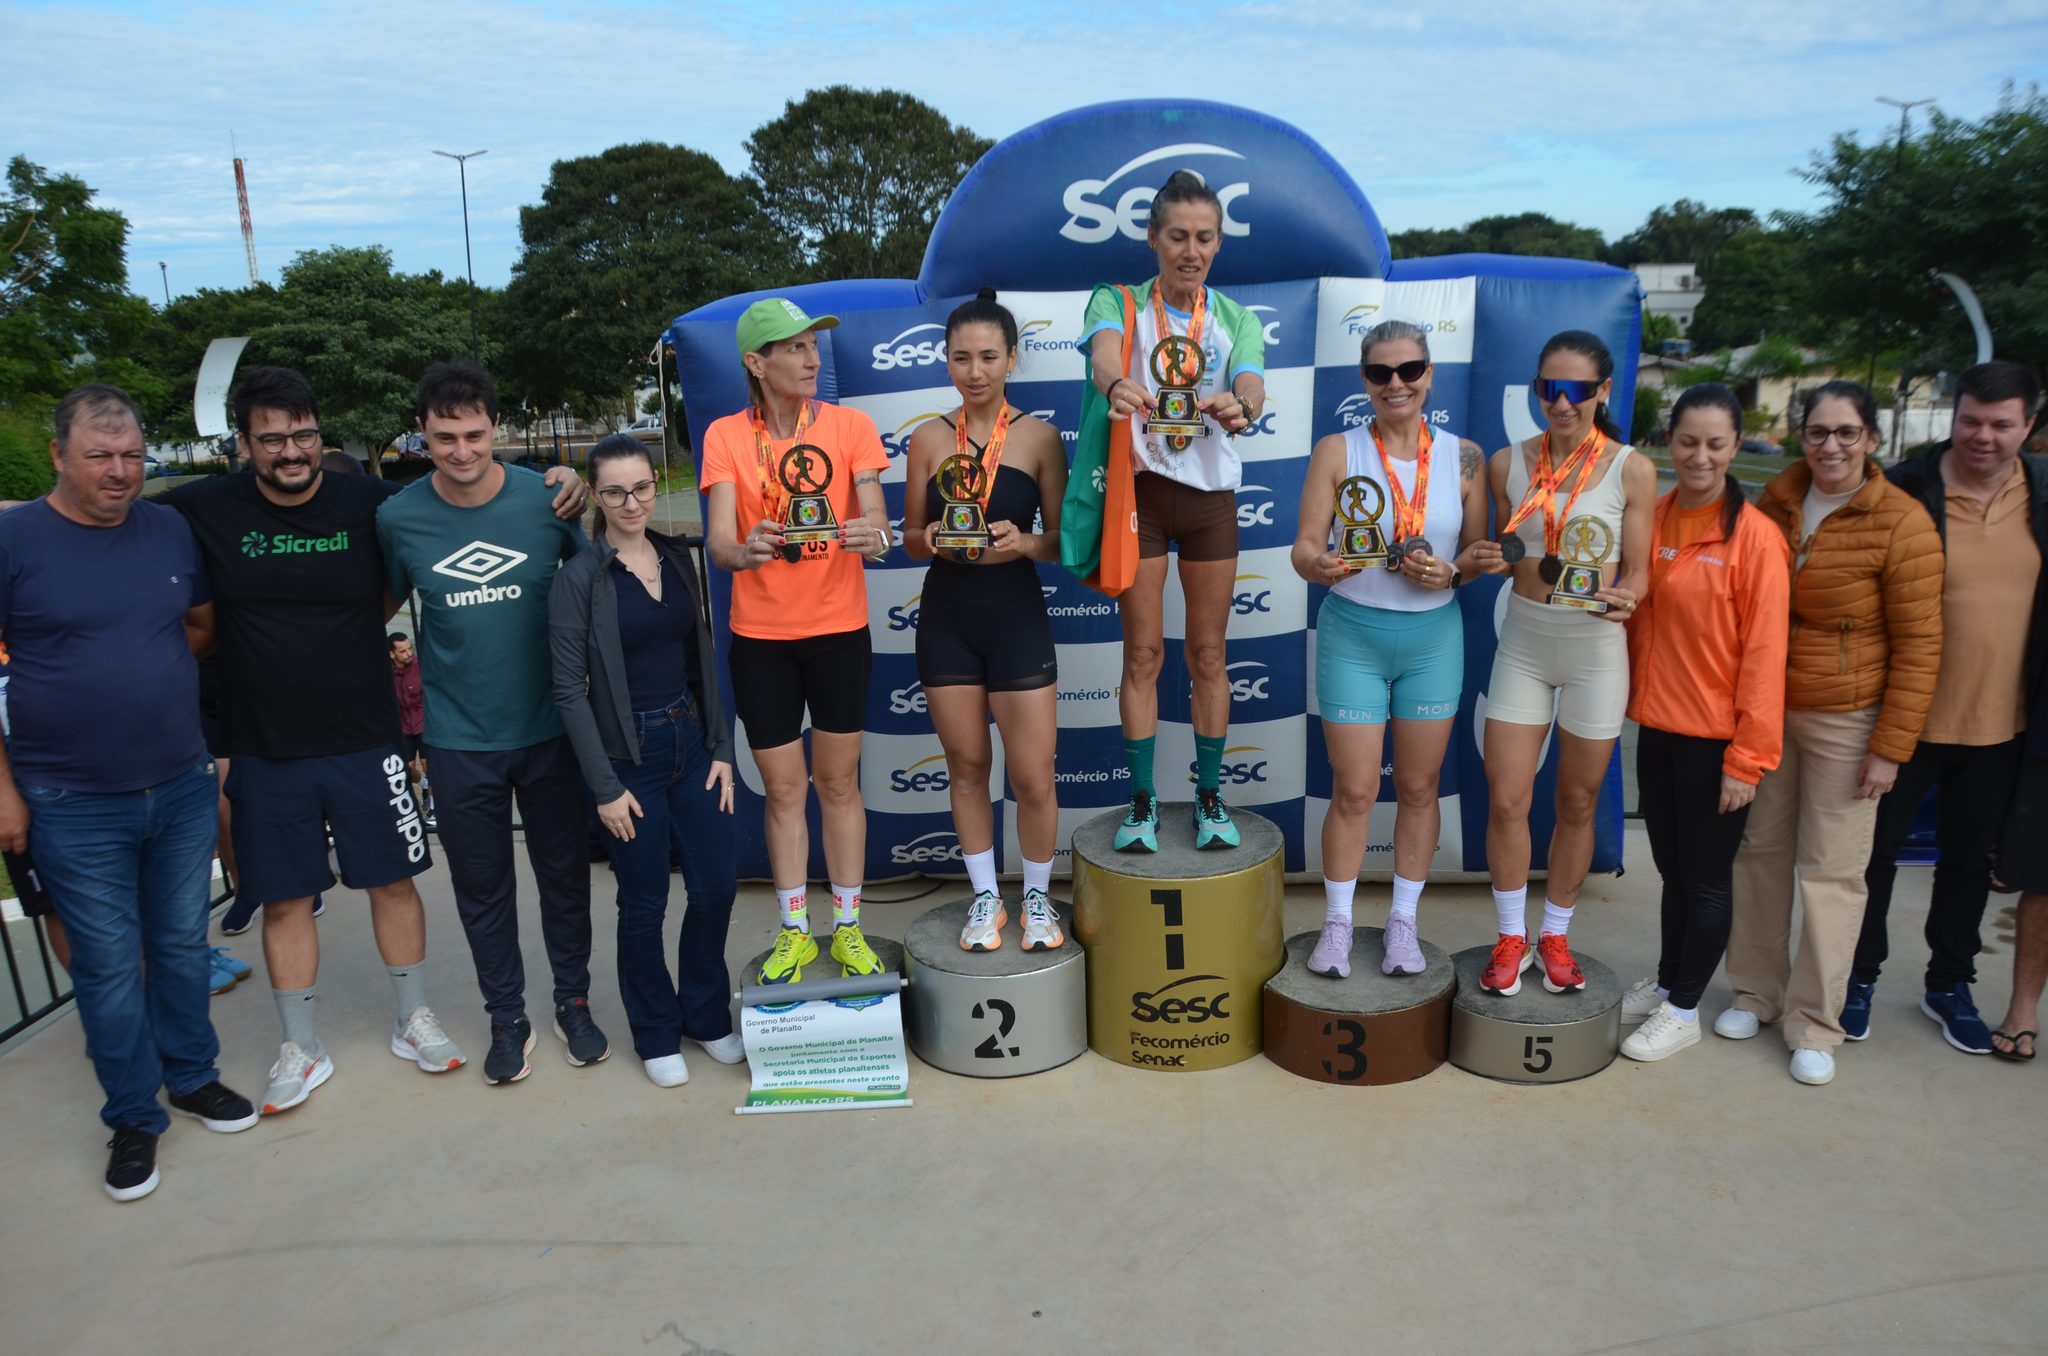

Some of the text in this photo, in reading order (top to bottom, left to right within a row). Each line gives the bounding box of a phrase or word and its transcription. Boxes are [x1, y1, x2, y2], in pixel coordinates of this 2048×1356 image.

[1059, 178, 1250, 243] Sec
[1438, 320, 1457, 333] RS
[1432, 410, 1449, 423] RS
[271, 531, 349, 554] Sicredi
[445, 584, 522, 608] umbro
[1047, 603, 1110, 616] comércio
[1338, 709, 1372, 720] RUN
[1113, 767, 1131, 780] RS
[382, 754, 425, 863] adidas
[1151, 889, 1184, 970] 1
[746, 1014, 816, 1027] Governo Municipal
[760, 1024, 802, 1034] de Planalto
[972, 999, 1020, 1058] 2
[805, 1040, 845, 1048] Municipal
[859, 1035, 893, 1044] Planalto
[1130, 1031, 1230, 1049] Fecomércio
[1322, 1019, 1368, 1081] 3
[1522, 1036, 1553, 1074] 5
[807, 1056, 846, 1064] Municipal
[860, 1053, 896, 1061] Esportes
[1132, 1051, 1185, 1067] Senac
[773, 1069, 795, 1077] apoia
[809, 1067, 837, 1075] atletas
[838, 1063, 890, 1074] planaltenses
[780, 1079, 802, 1087] estão
[804, 1077, 846, 1086] presentes
[871, 1074, 900, 1082] evento
